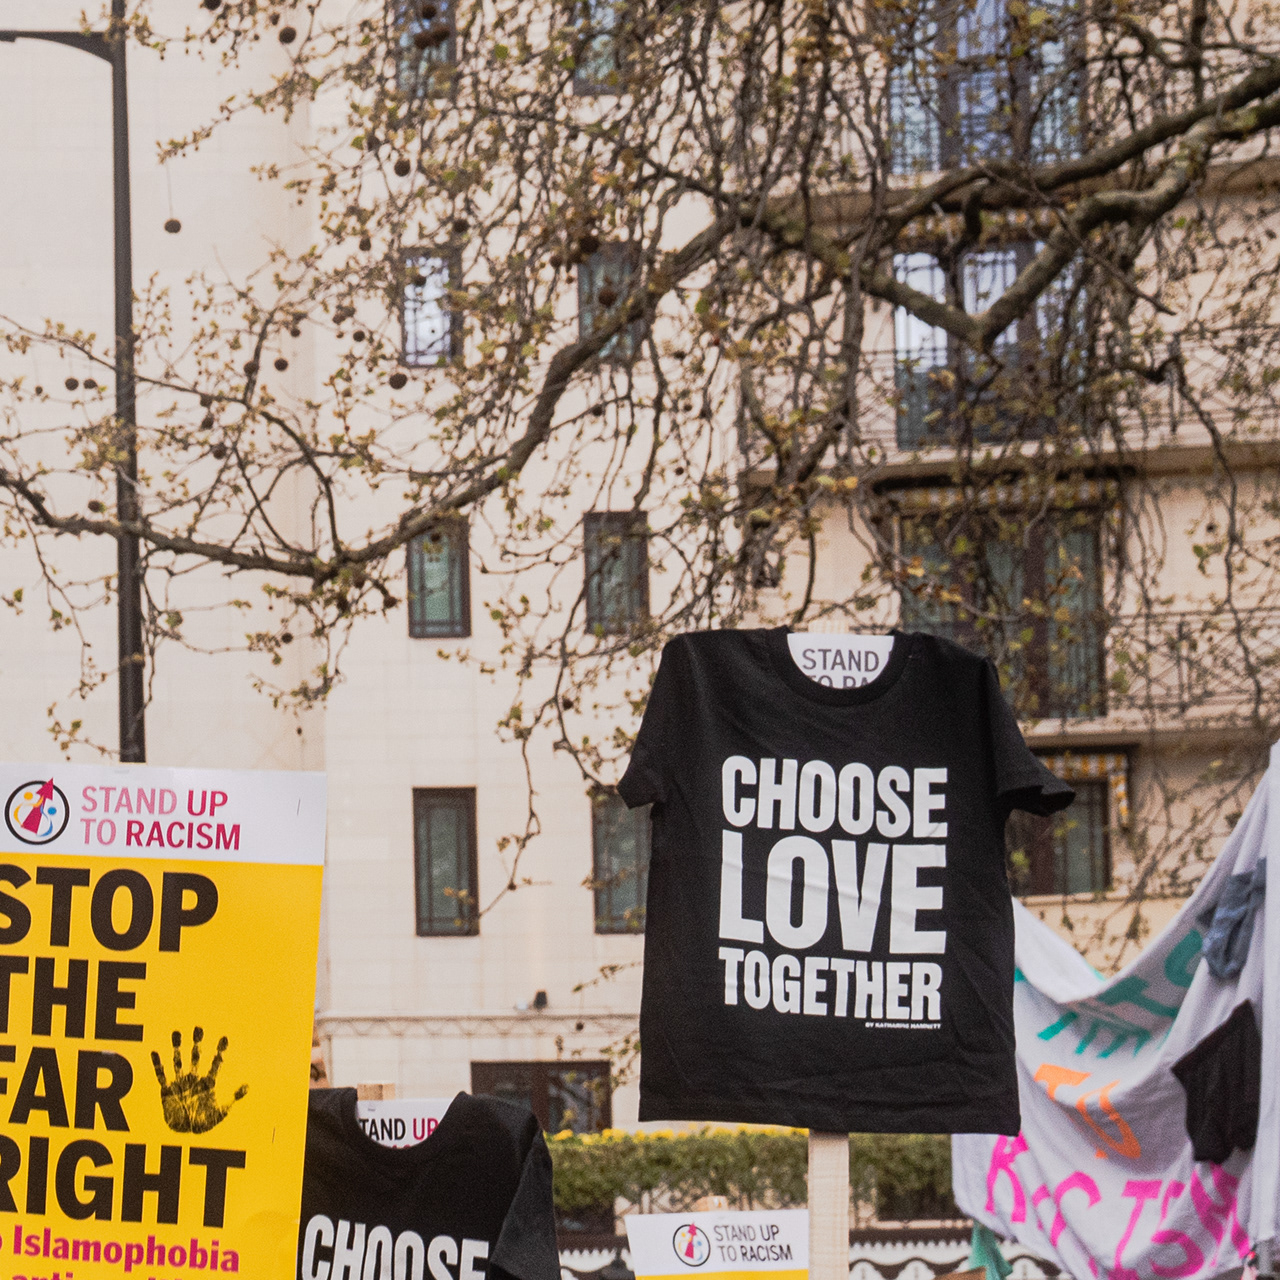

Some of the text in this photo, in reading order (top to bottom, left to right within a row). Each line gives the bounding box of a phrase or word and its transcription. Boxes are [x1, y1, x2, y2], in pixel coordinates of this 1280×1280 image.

[802, 648, 880, 672] STAND
[81, 785, 229, 819] STAND UP
[721, 755, 948, 838] CHOOSE
[80, 817, 242, 852] TO RACISM
[718, 829, 947, 954] LOVE
[718, 946, 942, 1021] TOGETHER
[13, 1226, 240, 1274] Islamophobia
[713, 1224, 779, 1243] STAND UP
[718, 1244, 793, 1262] TO RACISM
